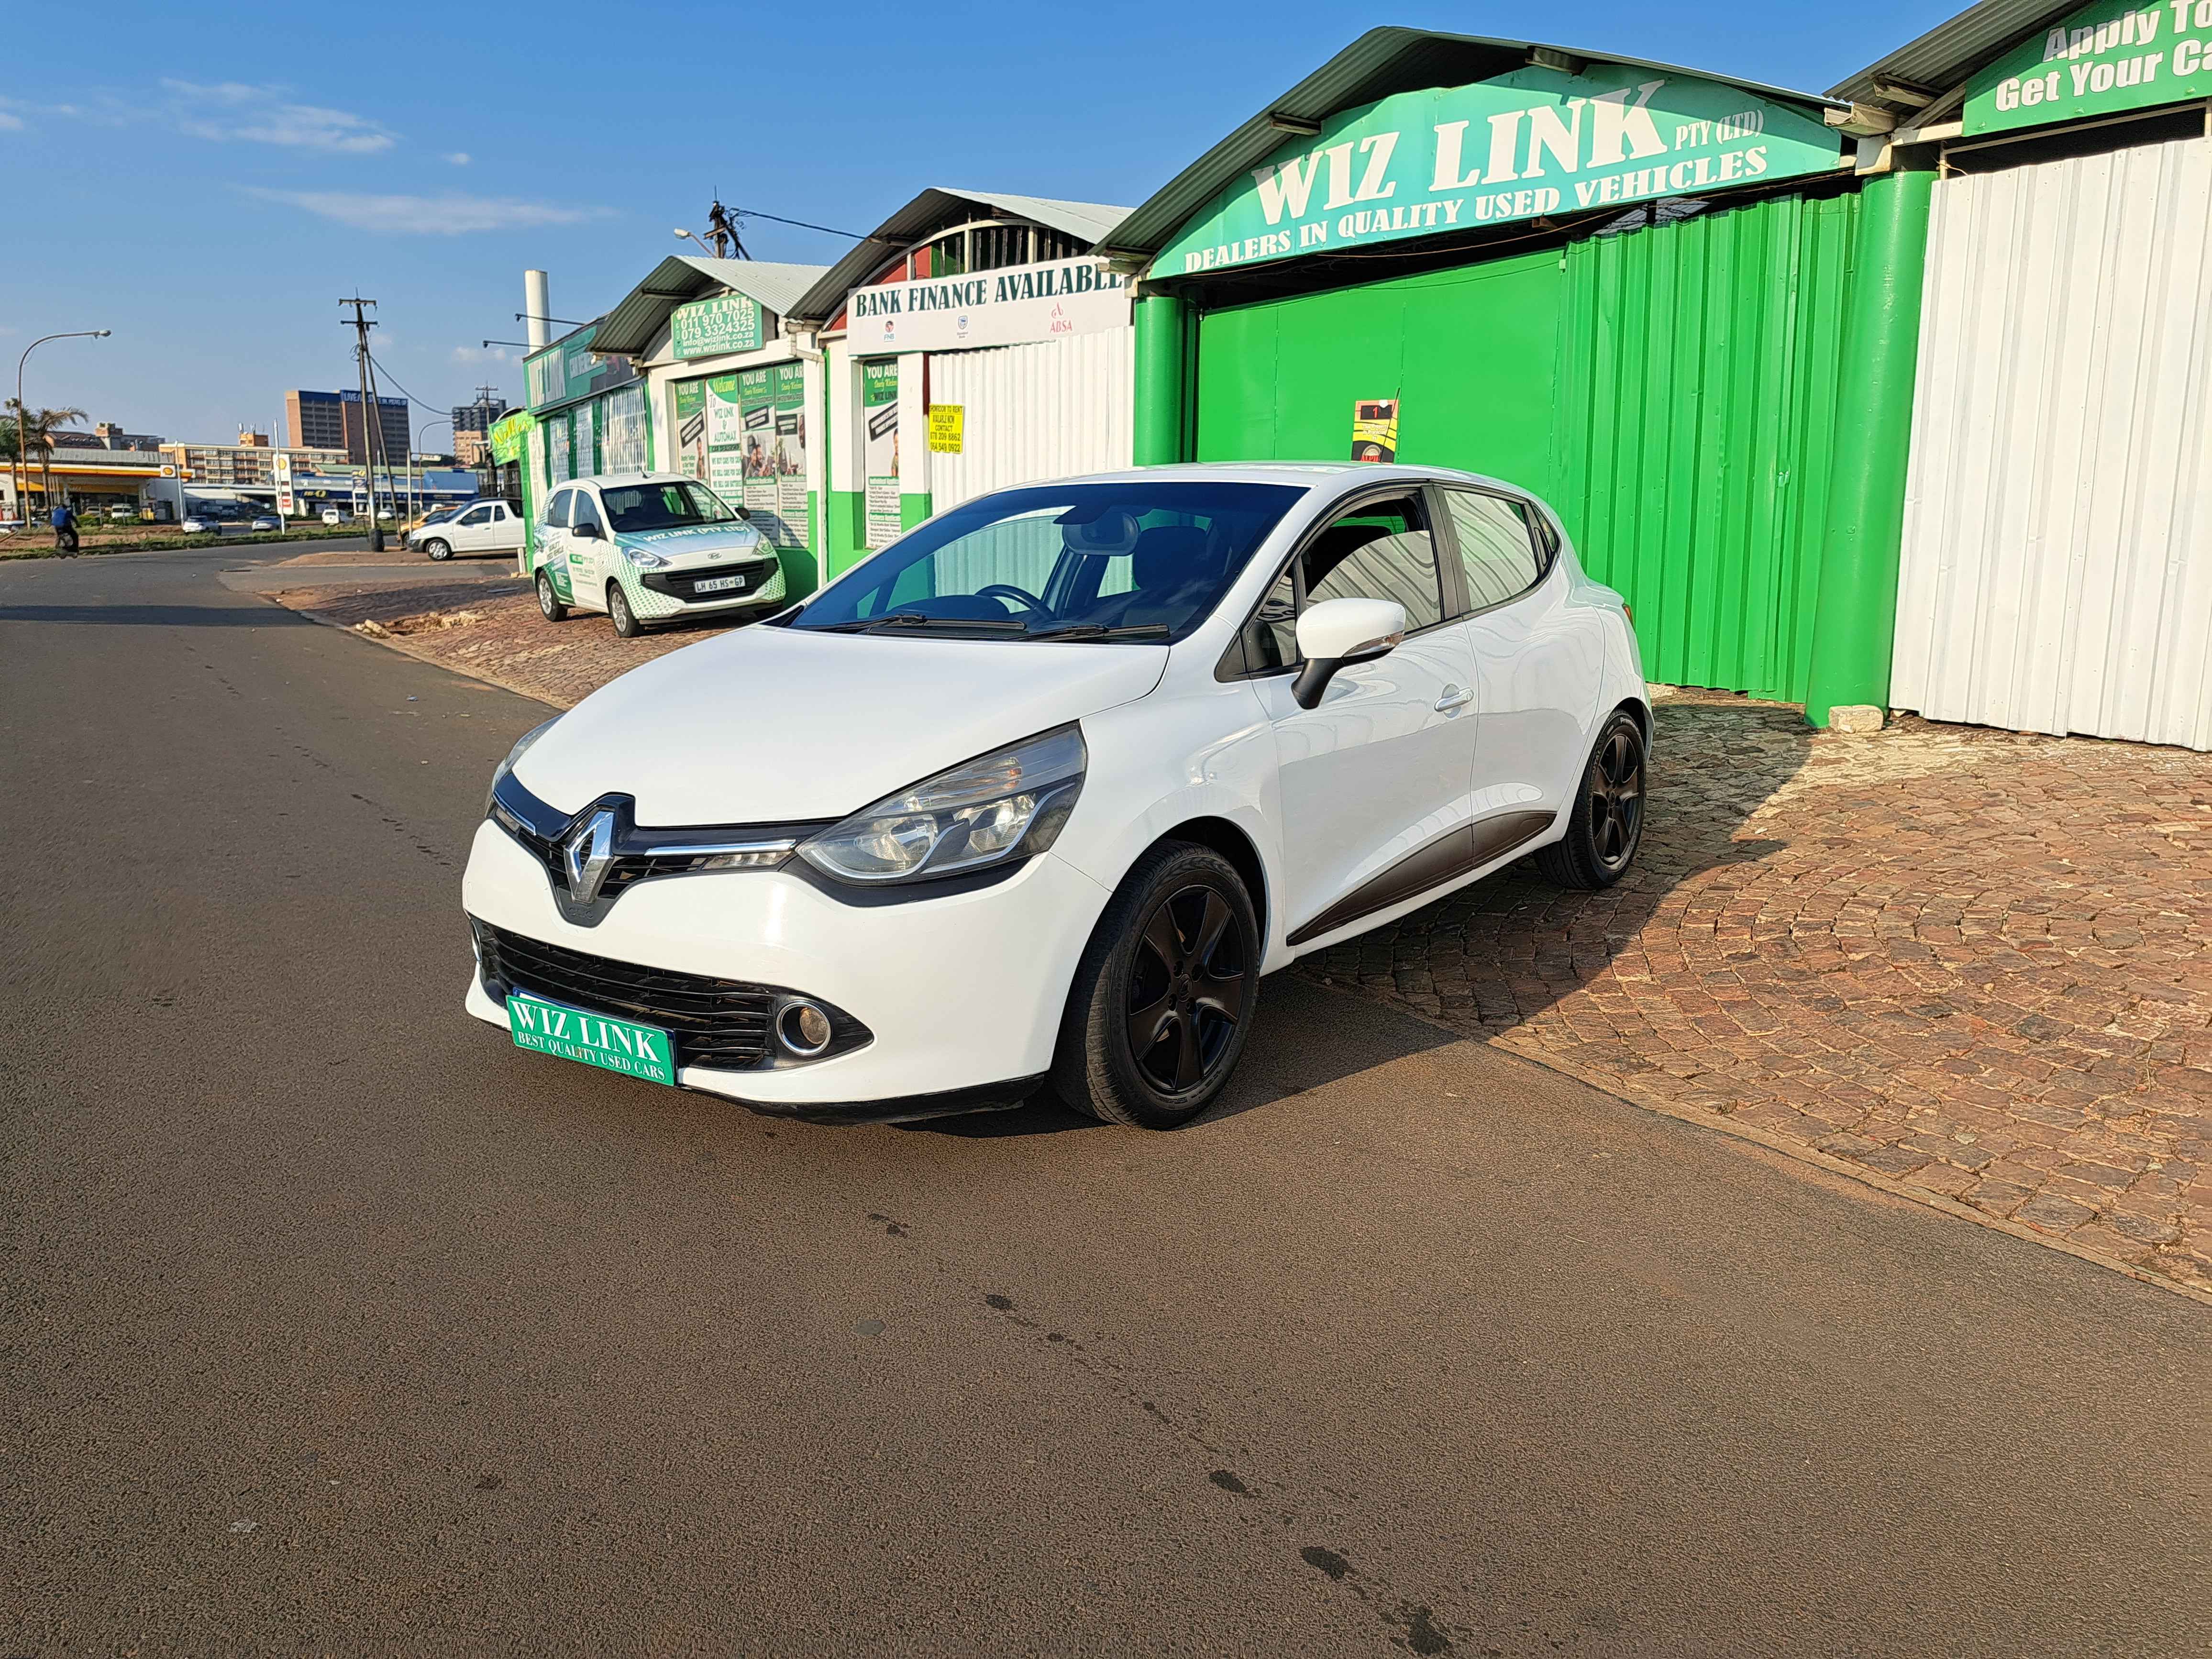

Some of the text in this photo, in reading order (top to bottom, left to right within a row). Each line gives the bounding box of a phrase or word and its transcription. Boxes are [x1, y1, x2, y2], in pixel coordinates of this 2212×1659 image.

[2043, 10, 2162, 63] Apply
[1995, 70, 2061, 112] Get
[2068, 51, 2164, 97] Your
[1251, 79, 1765, 225] WIZ LINK PTY (LTD)
[1184, 145, 1768, 273] DEALERS IN QUALITY USED VEHICLES
[856, 289, 902, 317] BANK
[907, 279, 987, 312] FINANCE
[676, 297, 754, 320] WIZ LINK
[681, 308, 754, 330] 011 970 7025
[1050, 320, 1072, 333] ABSA
[681, 319, 755, 340] 079 3324325
[683, 331, 754, 346] info@wizlink.co.za
[683, 339, 754, 355] www.wizlink.co.za
[742, 371, 766, 386] YOU ARE
[780, 365, 804, 380] YOU AR
[866, 364, 897, 379] YOU ARE
[678, 382, 699, 396] YOU ARE
[713, 376, 735, 393] Welcome
[643, 533, 668, 542] WIZ
[669, 529, 697, 538] LINK
[697, 526, 722, 535] (PTY
[697, 582, 706, 591] LH
[709, 581, 717, 589] 65
[735, 577, 743, 586] GP
[510, 1000, 662, 1063] WIZ LINK
[517, 1031, 665, 1080] BEST QUALITY USED CARS
